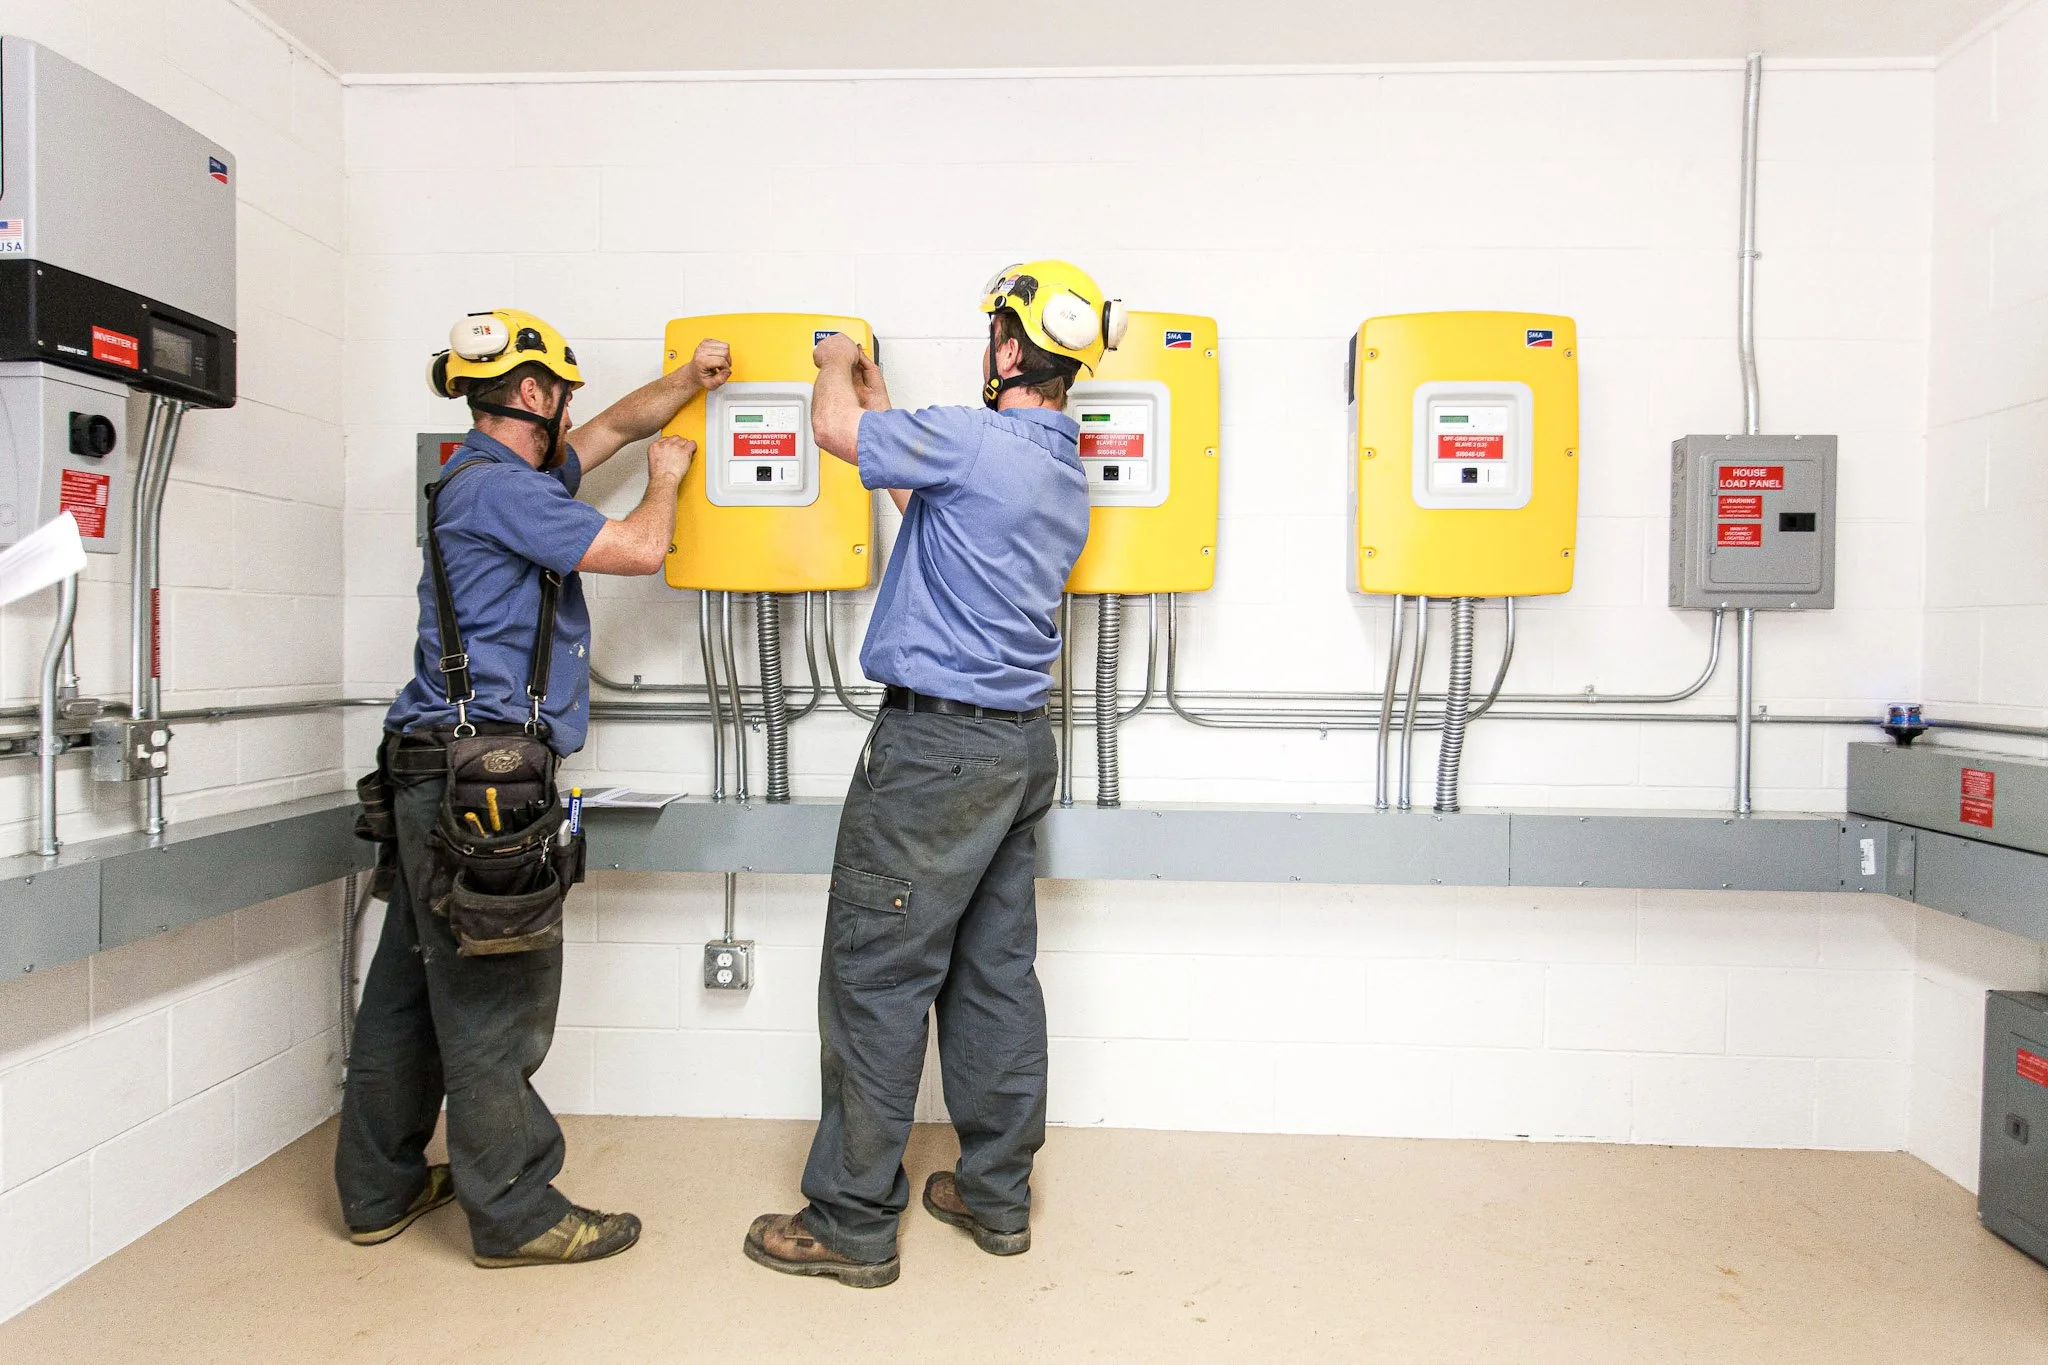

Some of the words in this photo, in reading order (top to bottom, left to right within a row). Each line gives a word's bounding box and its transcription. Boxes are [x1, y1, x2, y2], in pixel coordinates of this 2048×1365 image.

[0, 242, 22, 252] USA
[93, 330, 132, 349] INVERTER
[816, 332, 831, 340] SMA
[1528, 331, 1544, 339] SMA
[1732, 468, 1767, 477] HOUSE
[1719, 479, 1748, 488] LOAD
[1749, 479, 1782, 488] PANEL
